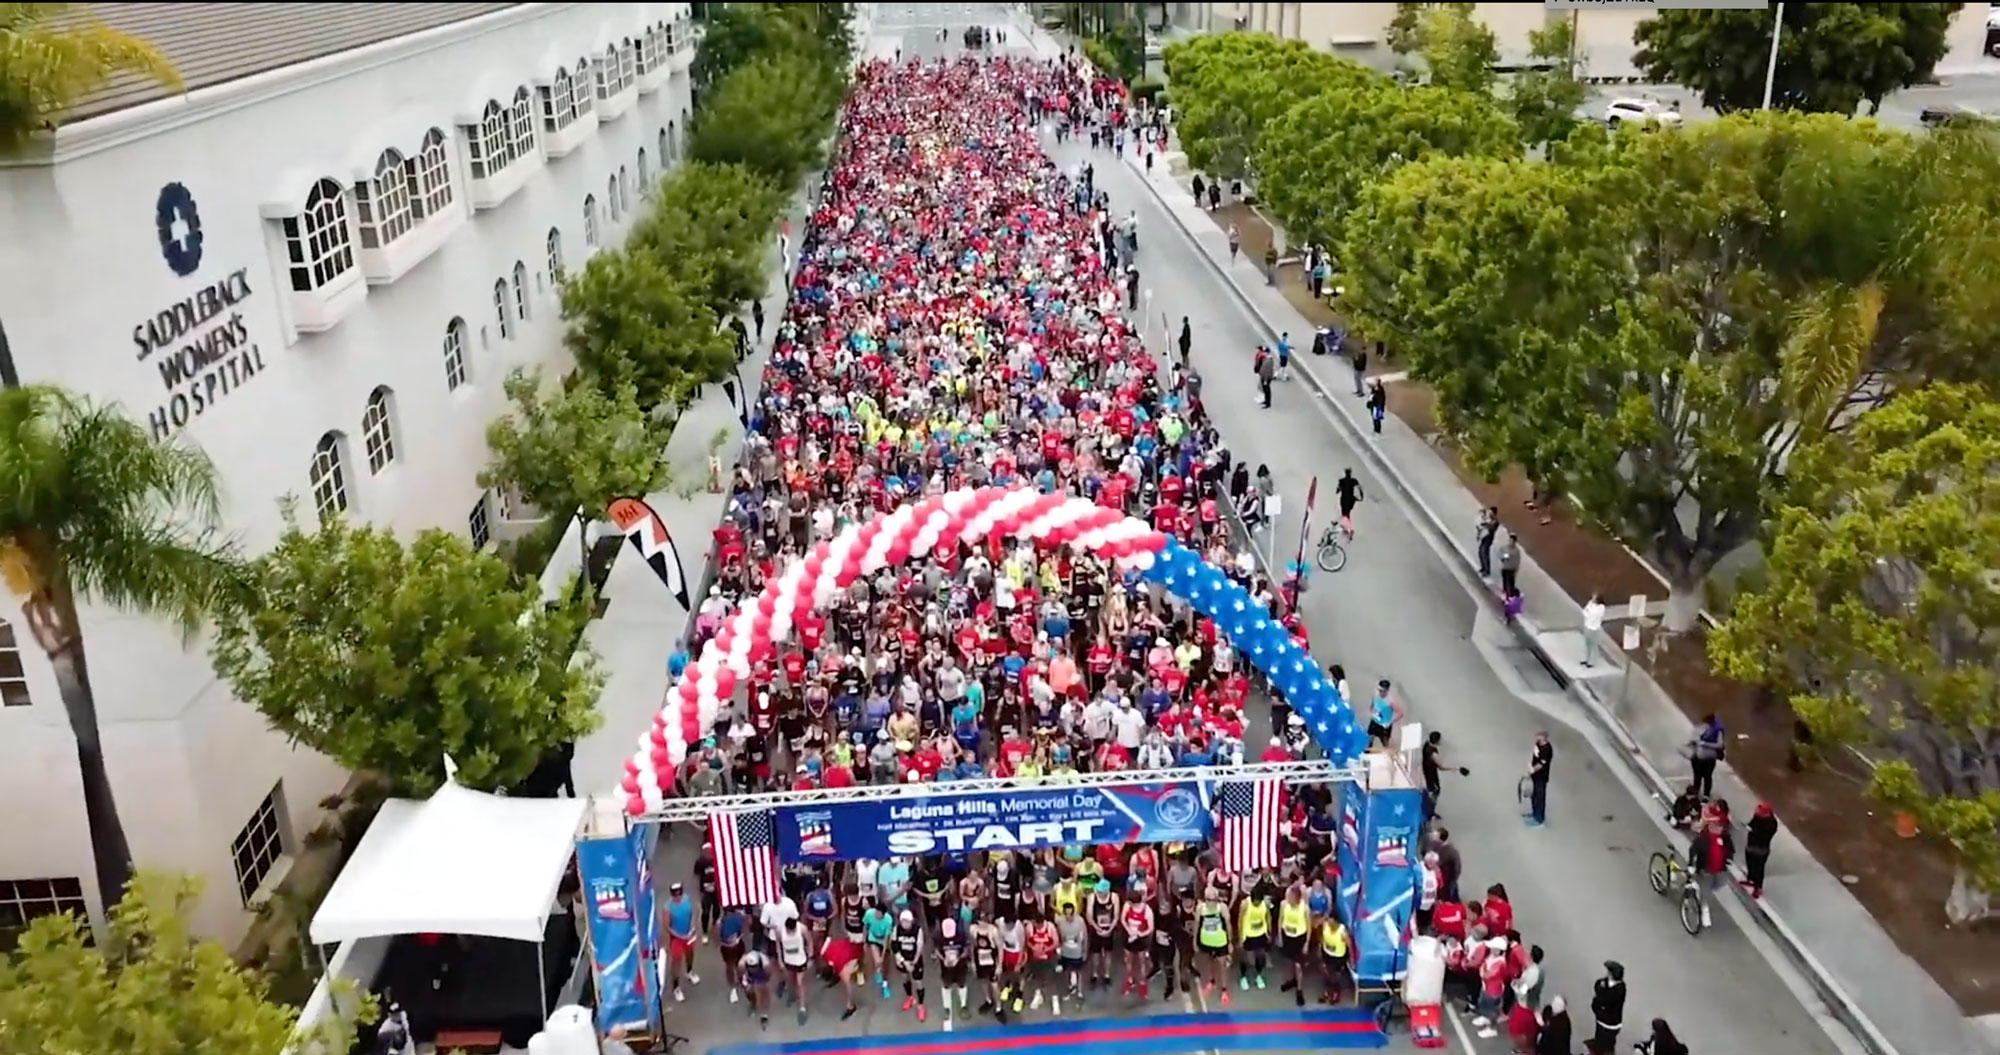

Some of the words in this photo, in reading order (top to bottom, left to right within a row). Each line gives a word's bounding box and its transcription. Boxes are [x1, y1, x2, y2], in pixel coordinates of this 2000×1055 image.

[133, 267, 252, 361] SADDLEBACK
[158, 311, 247, 391] WOMEN'S
[149, 344, 265, 443] HOSPITAL
[888, 819, 1104, 854] START
[890, 805, 954, 820] Laguna
[958, 799, 997, 815] Hills
[1001, 796, 1068, 813] Memorial
[1073, 794, 1103, 809] Day
